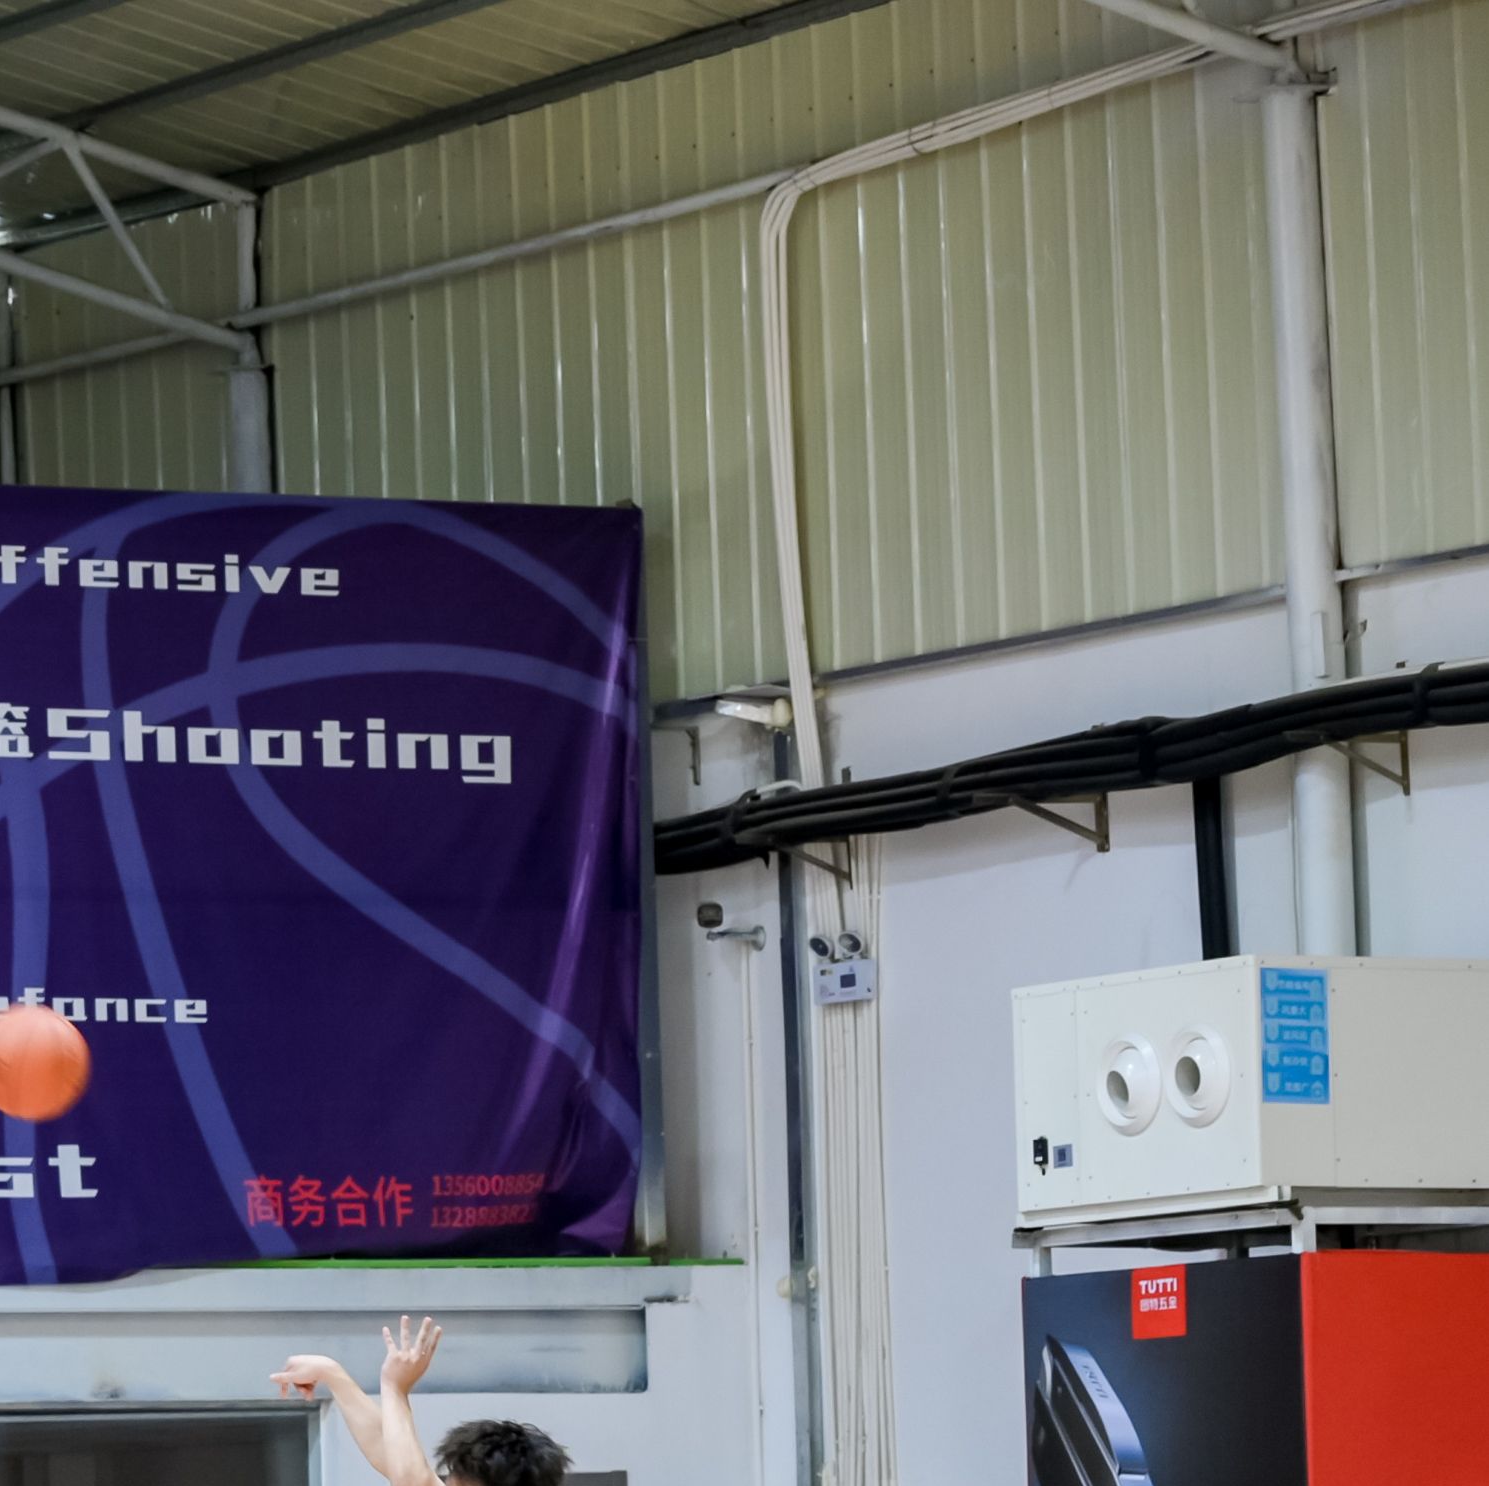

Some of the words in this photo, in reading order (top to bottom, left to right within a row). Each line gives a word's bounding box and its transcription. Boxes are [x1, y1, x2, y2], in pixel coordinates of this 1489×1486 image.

[244, 1174, 413, 1228] 商务合作
[1139, 1277, 1178, 1295] TUTTI
